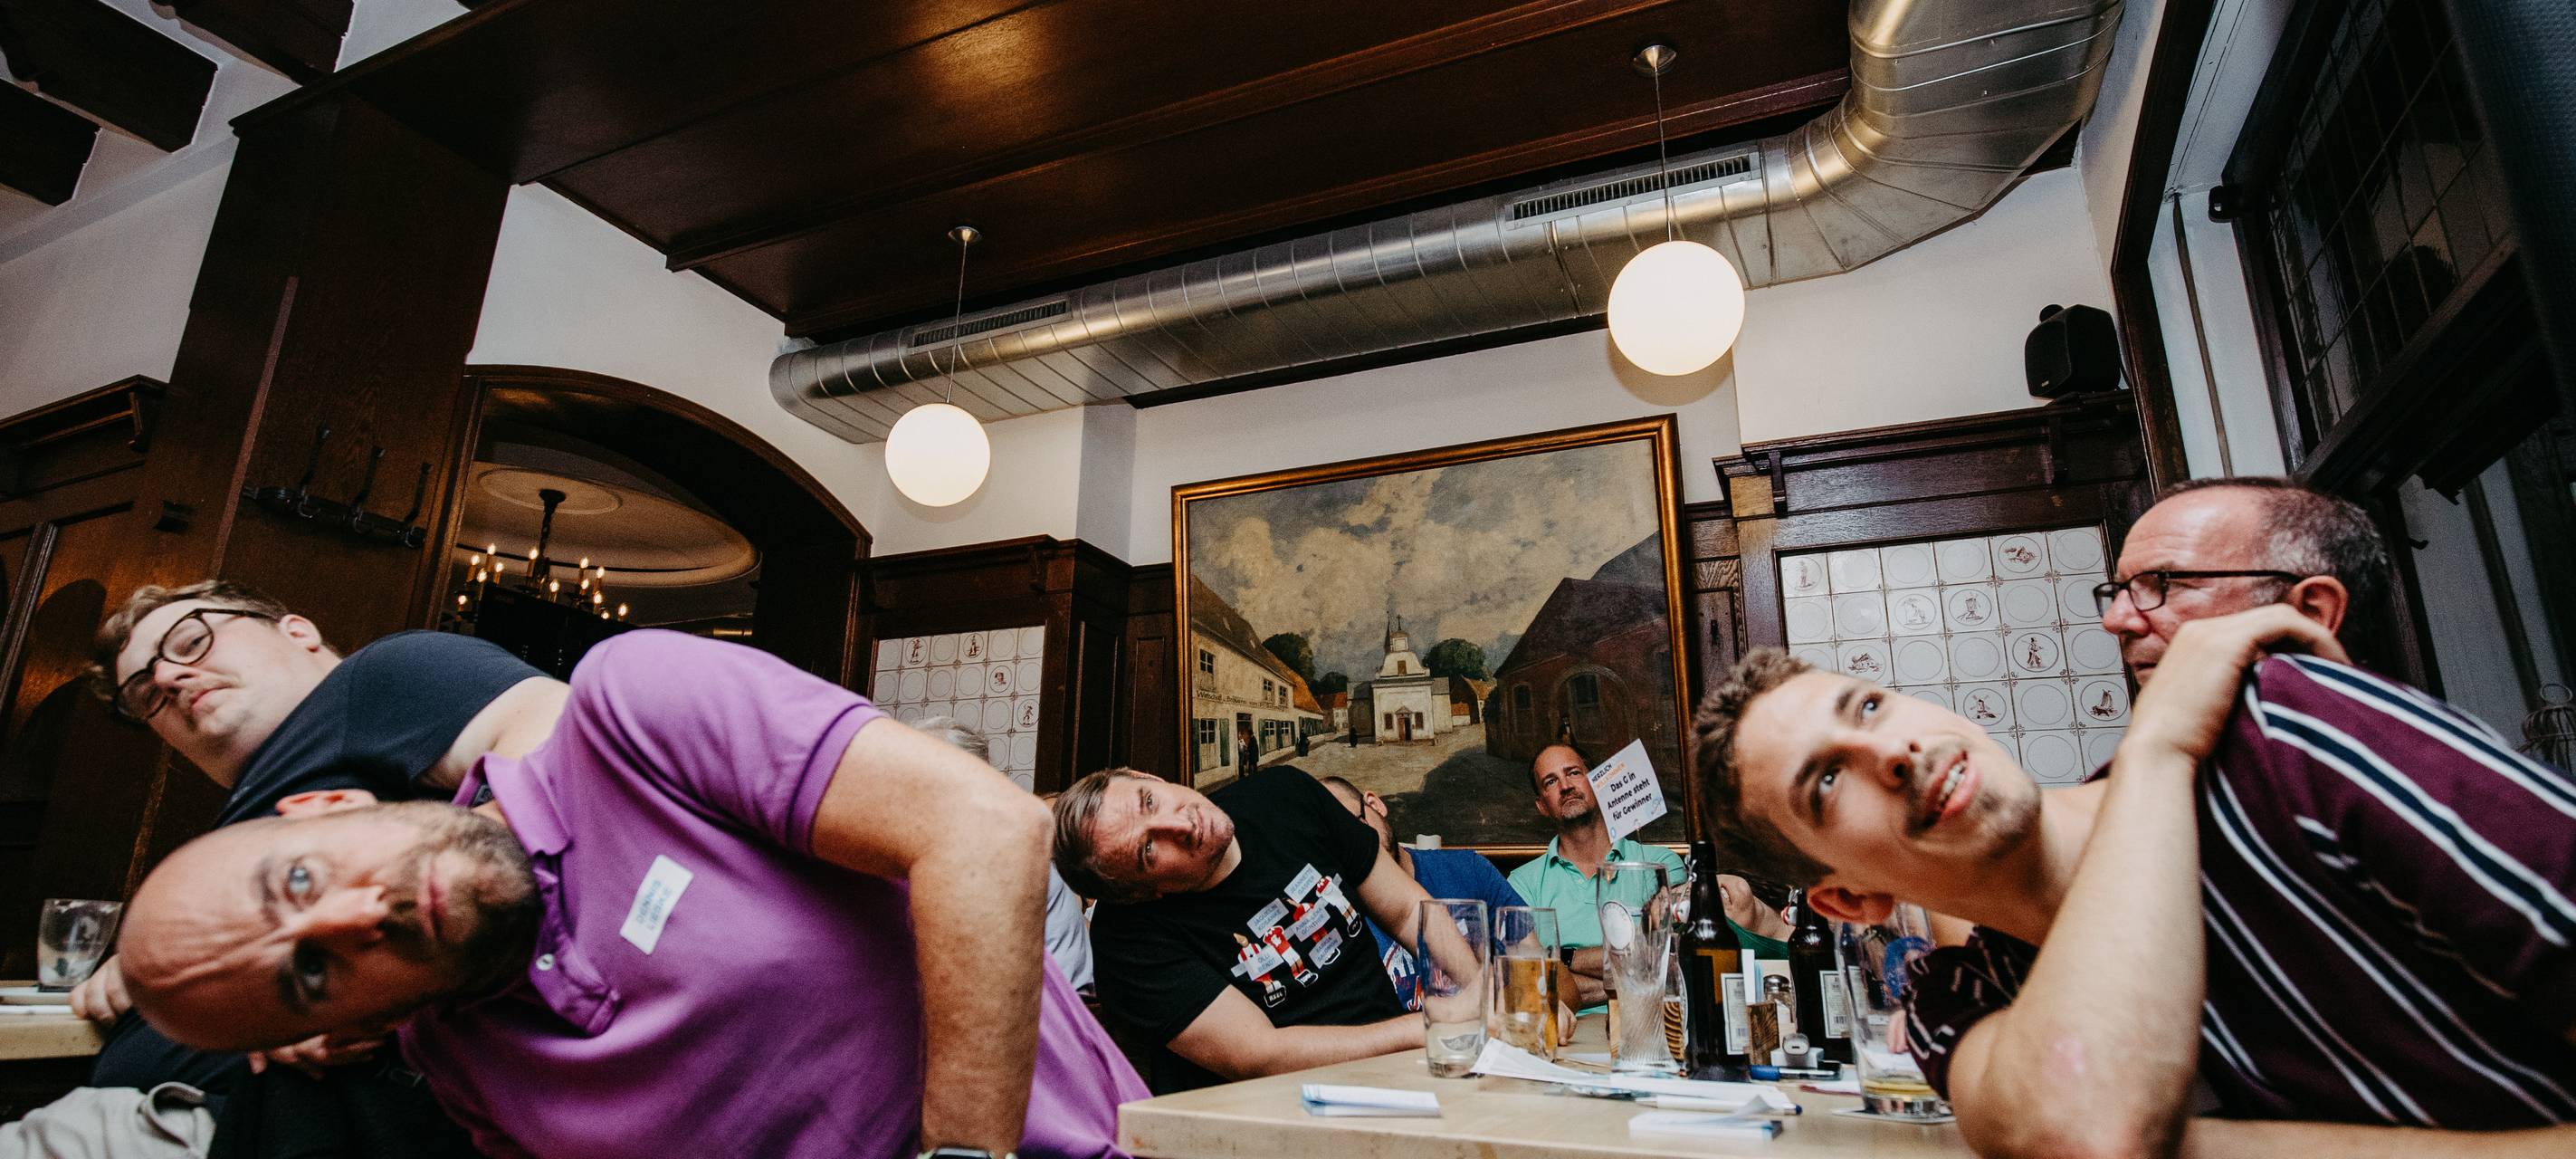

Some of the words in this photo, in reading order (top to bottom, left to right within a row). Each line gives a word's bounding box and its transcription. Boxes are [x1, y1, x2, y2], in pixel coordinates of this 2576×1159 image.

[1592, 763, 1613, 783] HERZLICH
[1610, 781, 1623, 792] Das
[1622, 775, 1629, 784] G
[1627, 771, 1636, 781] in
[1608, 790, 1633, 810] Antenne
[1633, 778, 1651, 794] steht
[1612, 811, 1622, 821] für
[1622, 793, 1652, 815] Gewinner
